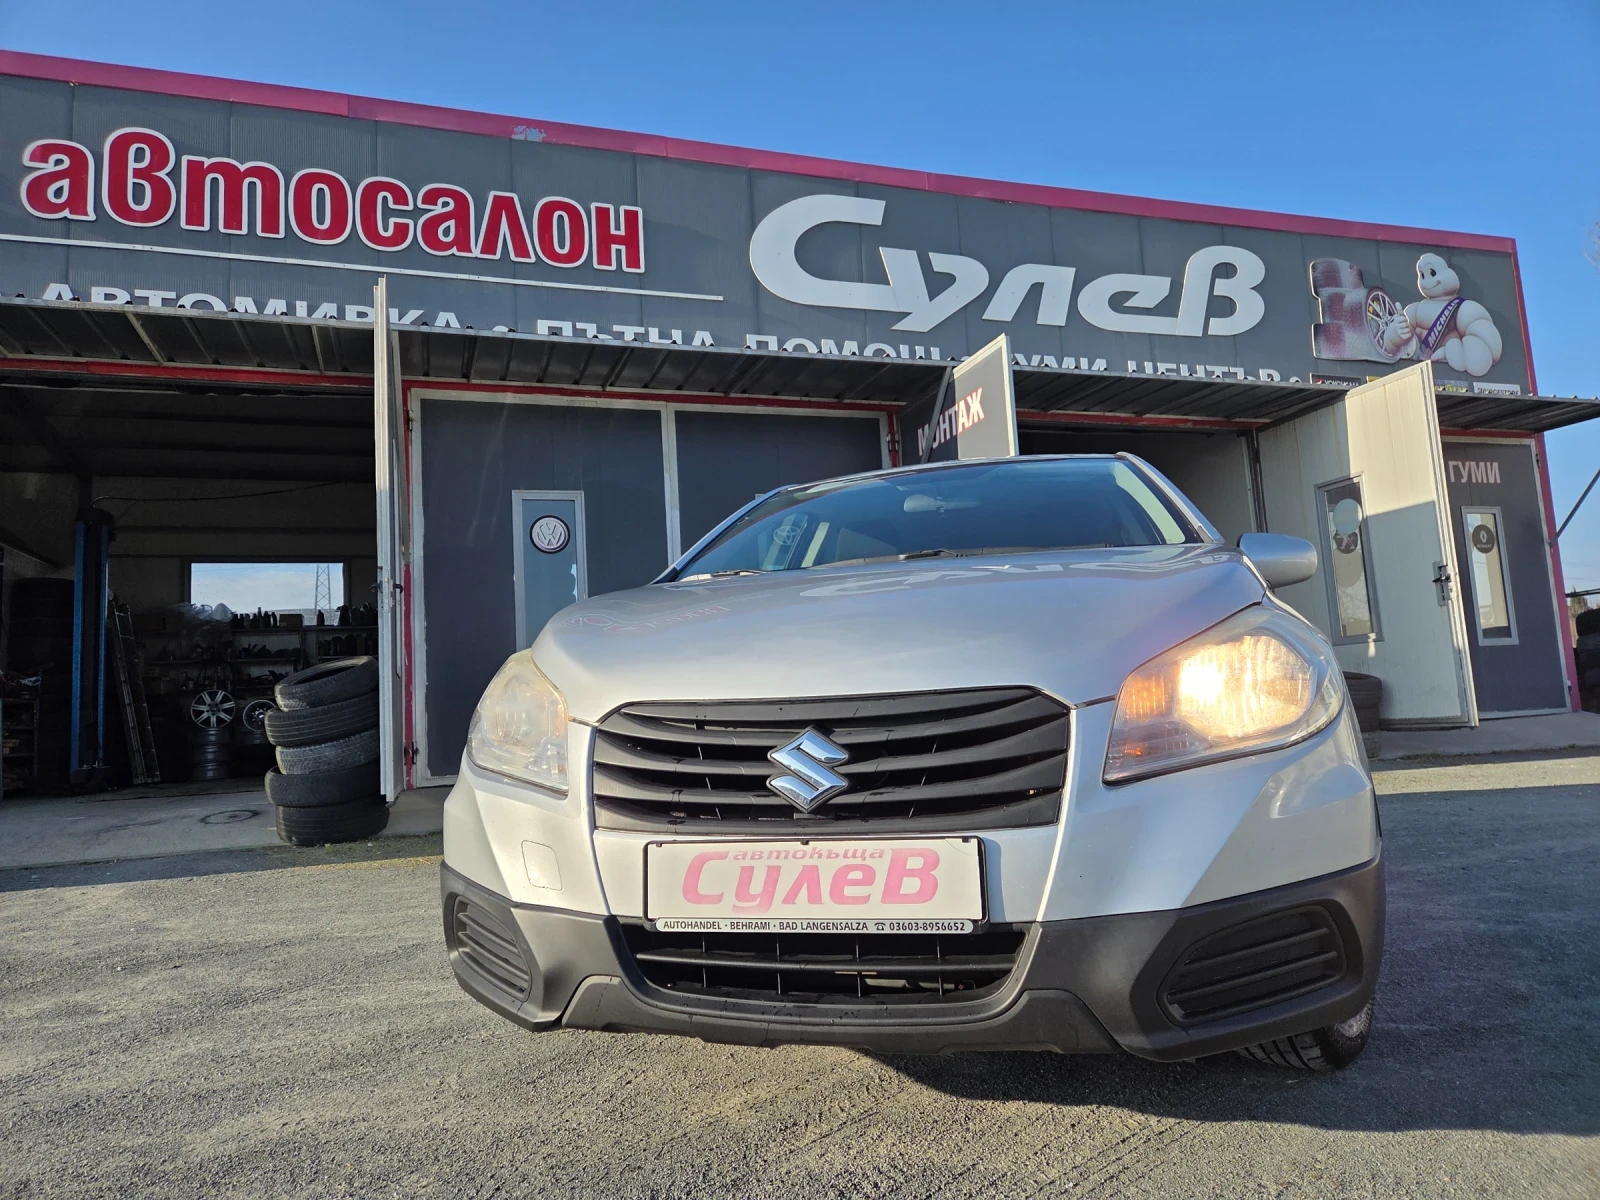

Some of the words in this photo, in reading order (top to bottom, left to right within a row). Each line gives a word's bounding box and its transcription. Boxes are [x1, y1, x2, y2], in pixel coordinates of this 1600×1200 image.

[21, 127, 645, 273] автосалон
[1427, 298, 1461, 347] MICHELIN
[1448, 460, 1501, 484] ГУМИ
[733, 846, 885, 861] автокъща
[663, 920, 722, 930] AUTOHANDEL
[730, 921, 771, 931] BEHRAMI
[779, 921, 798, 931] BAD
[801, 921, 868, 931] LANGENSALZA
[889, 921, 965, 931] 03603-8956652
